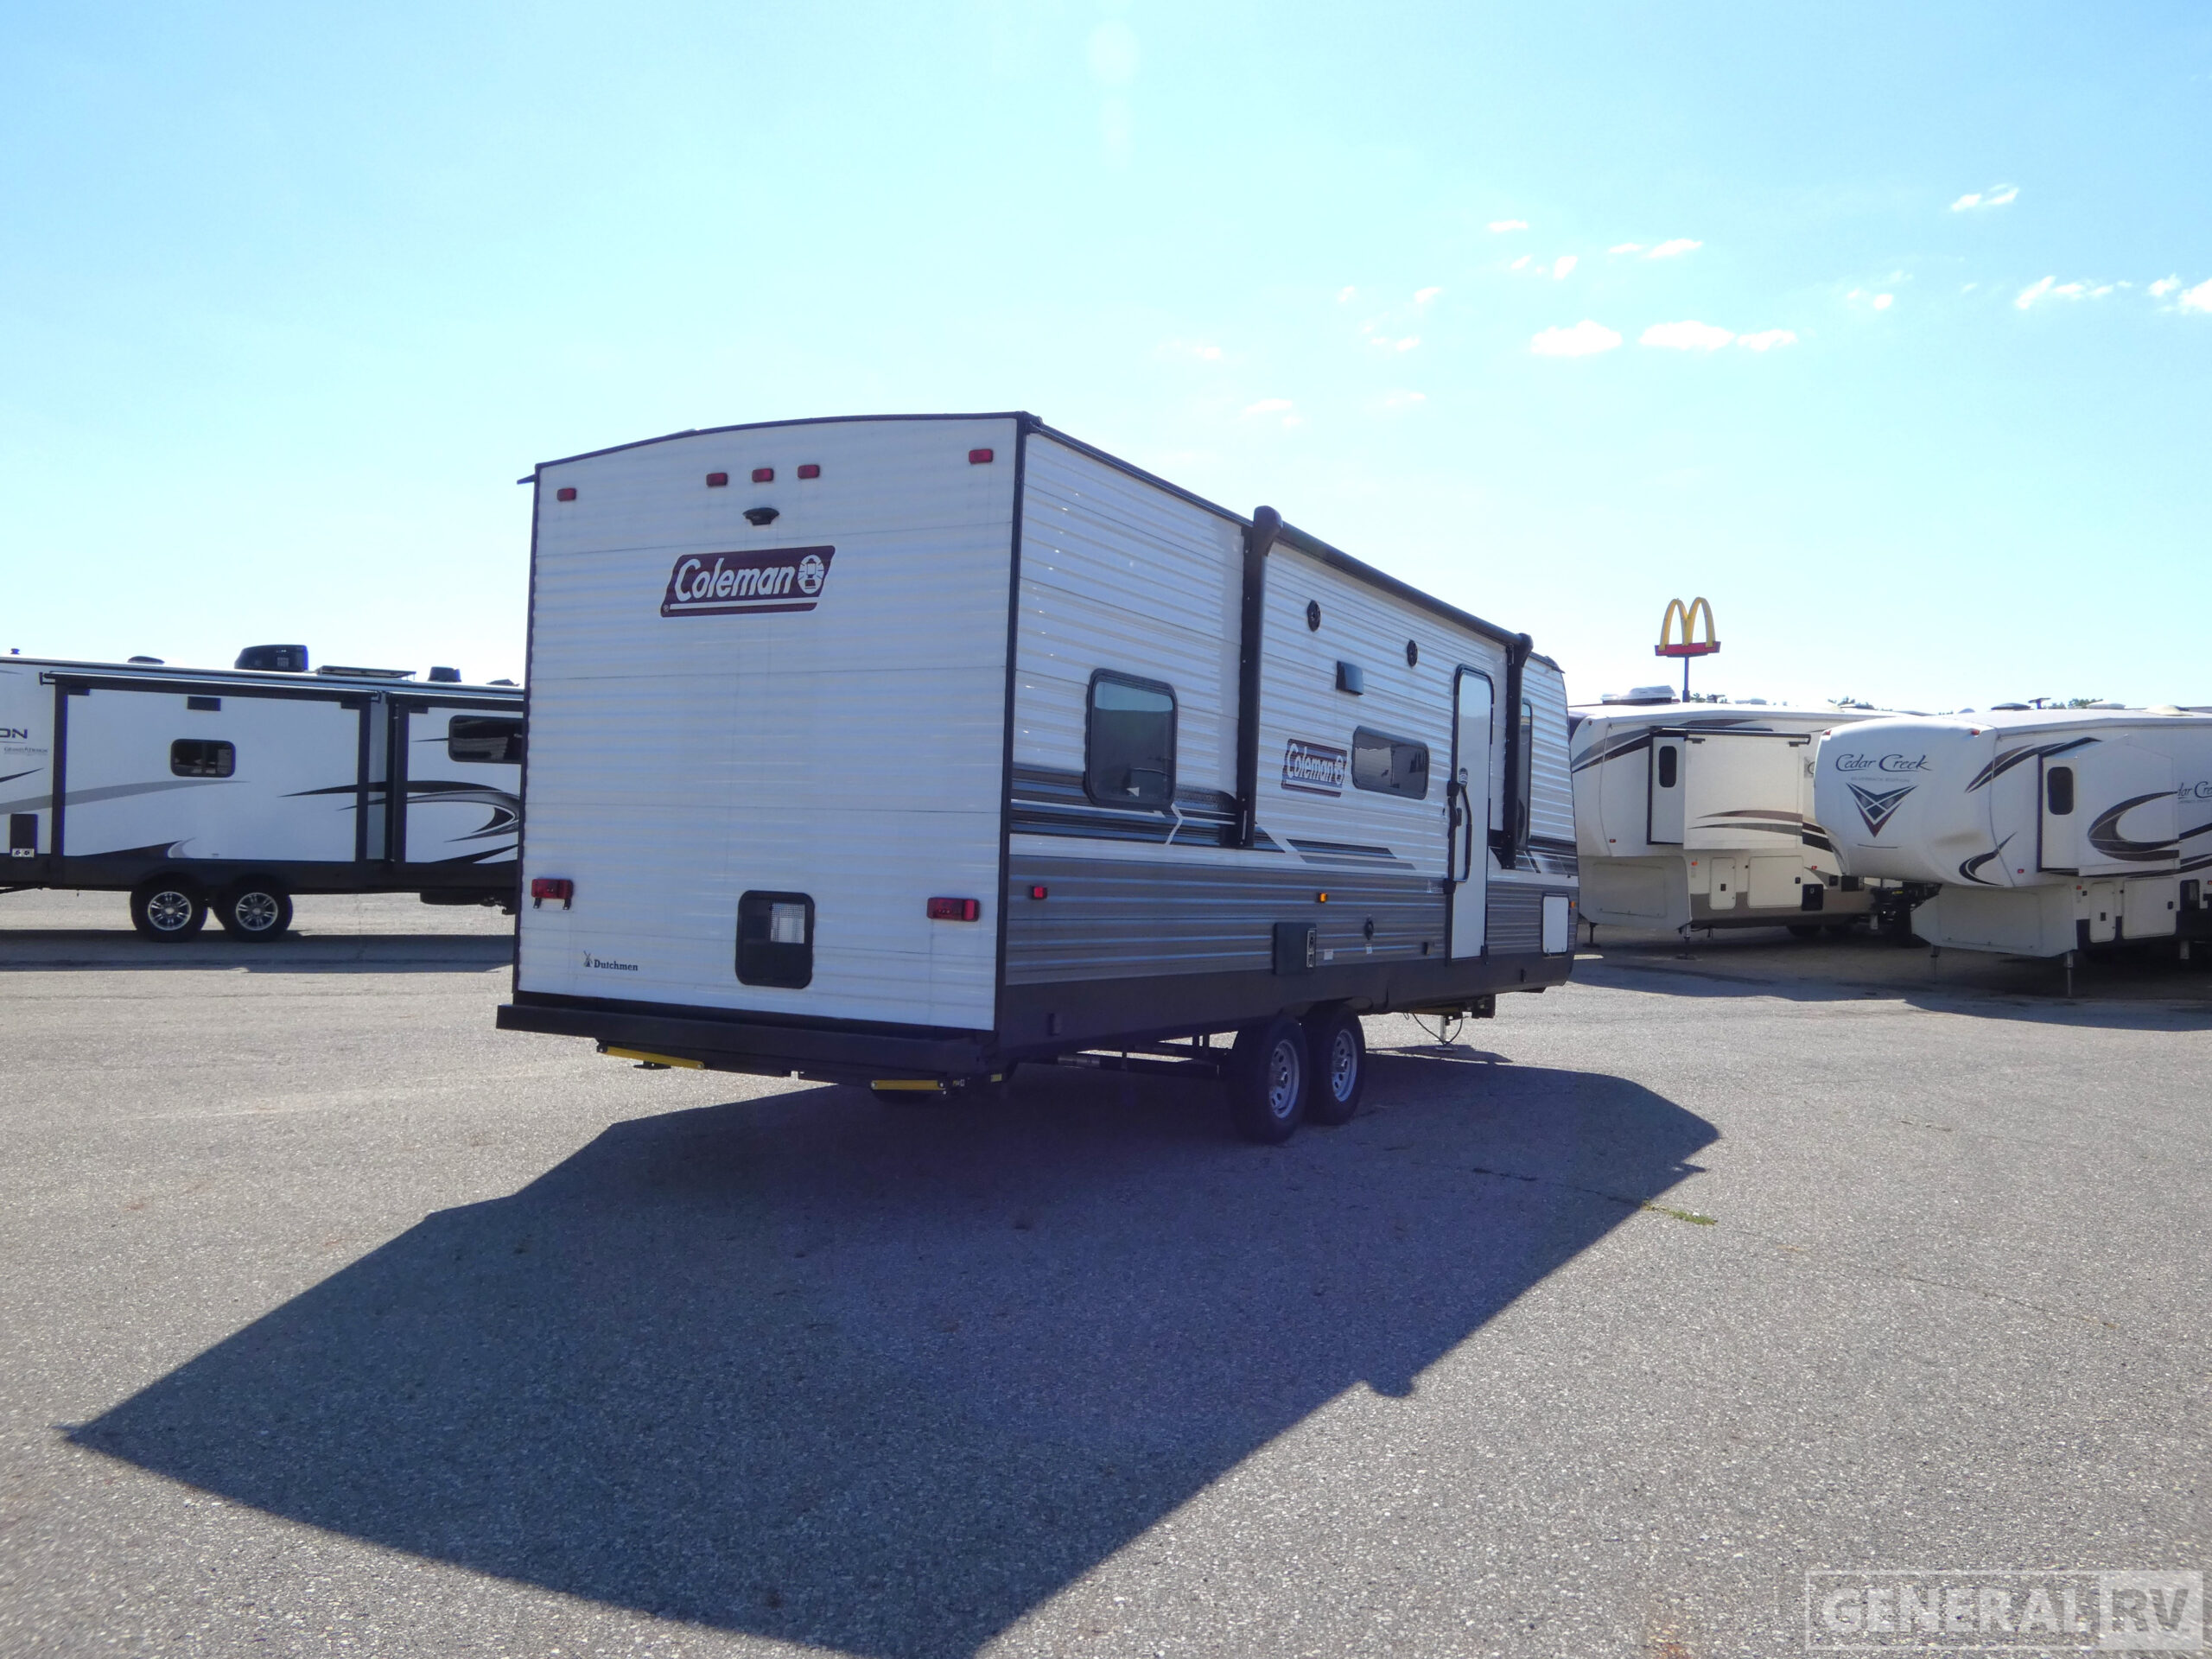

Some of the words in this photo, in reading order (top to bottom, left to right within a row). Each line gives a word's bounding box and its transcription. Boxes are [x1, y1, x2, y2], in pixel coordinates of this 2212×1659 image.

[675, 557, 796, 602] Coleman
[1287, 743, 1334, 783] Coleman
[1835, 753, 1877, 772] Cedar
[1878, 753, 1933, 772] Creek
[594, 958, 639, 971] Dutchmen
